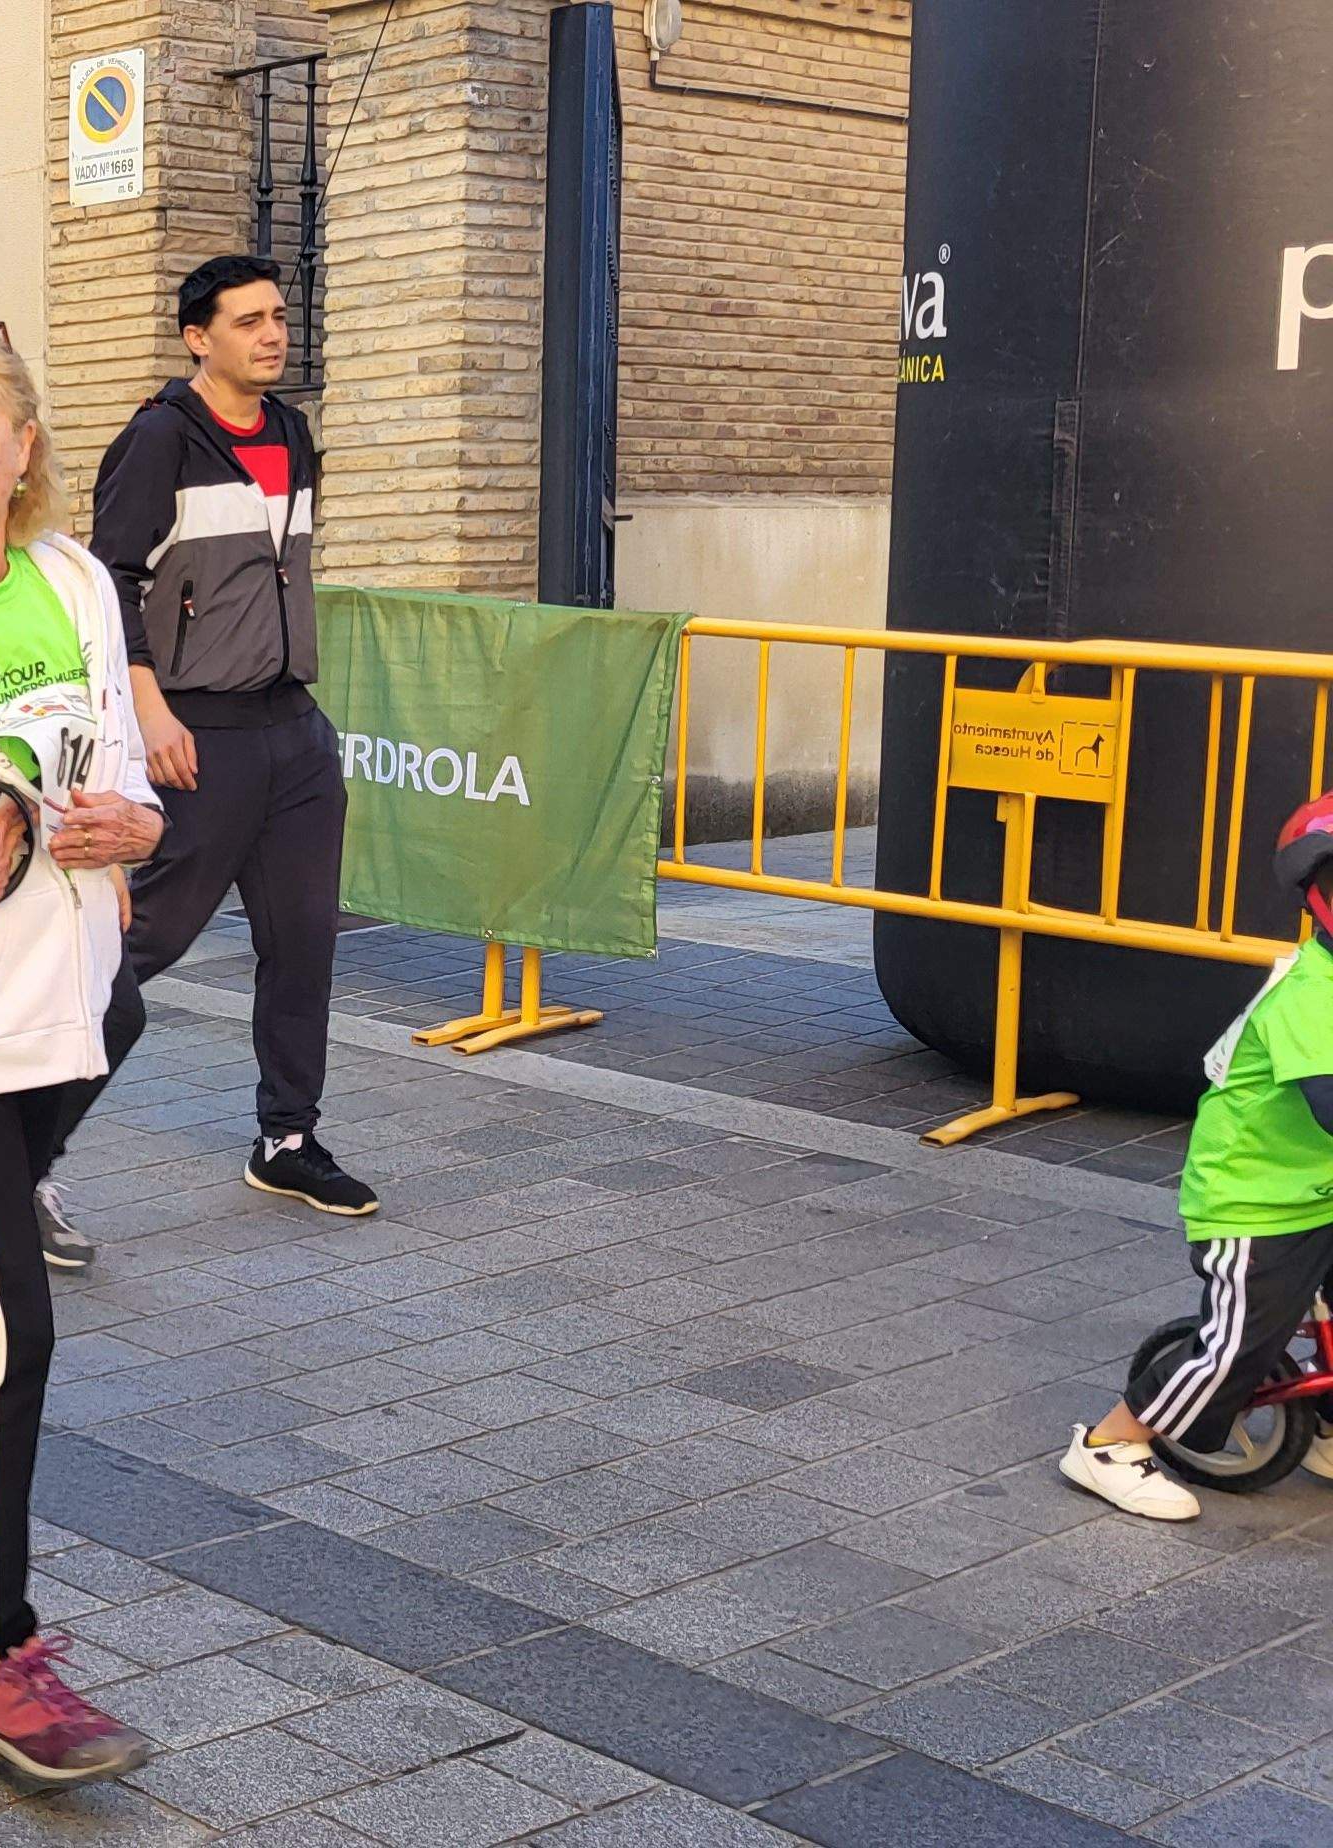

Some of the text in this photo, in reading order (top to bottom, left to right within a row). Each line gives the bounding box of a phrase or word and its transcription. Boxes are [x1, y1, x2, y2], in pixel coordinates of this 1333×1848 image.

[74, 163, 98, 181] VADO
[127, 182, 134, 193] 6
[898, 271, 948, 341] va
[0, 660, 47, 687] TOUR
